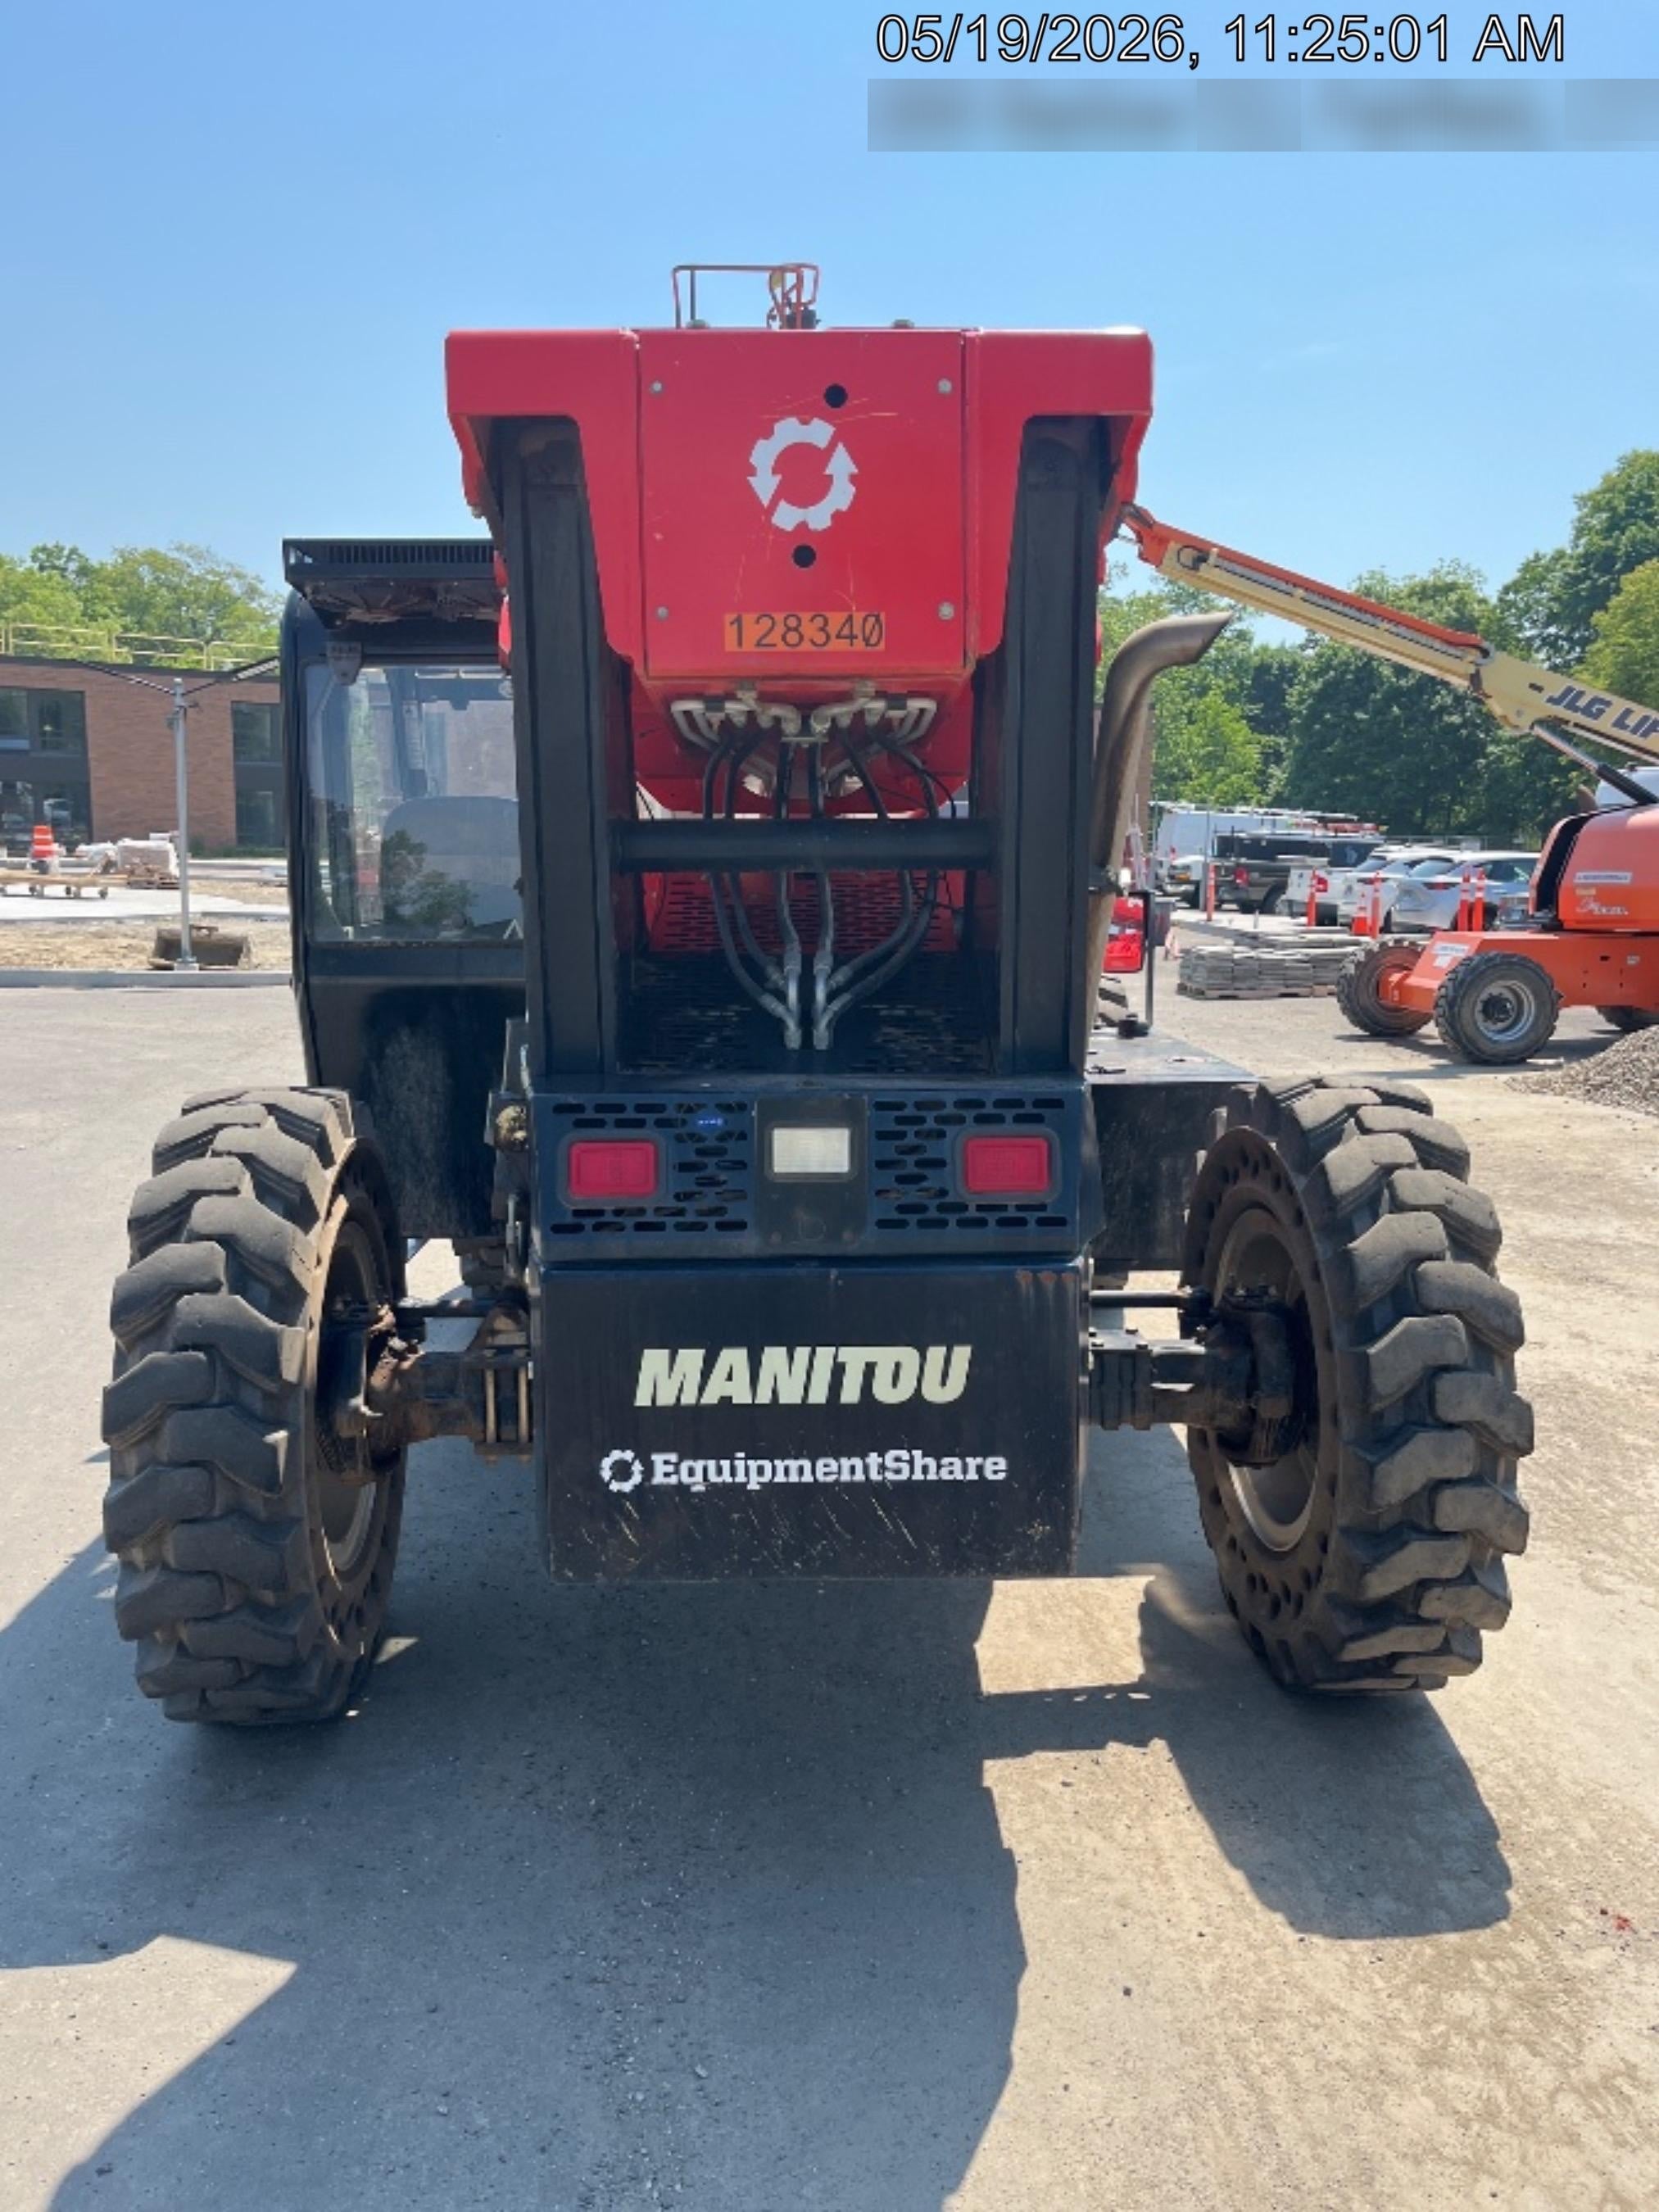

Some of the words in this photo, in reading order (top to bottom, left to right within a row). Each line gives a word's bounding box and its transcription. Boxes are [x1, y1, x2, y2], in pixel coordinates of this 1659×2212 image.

[728, 612, 884, 649] 128340
[1545, 685, 1613, 721] JLG
[634, 1344, 972, 1407] MANITOU
[650, 1448, 1009, 1493] EquipmentShare
